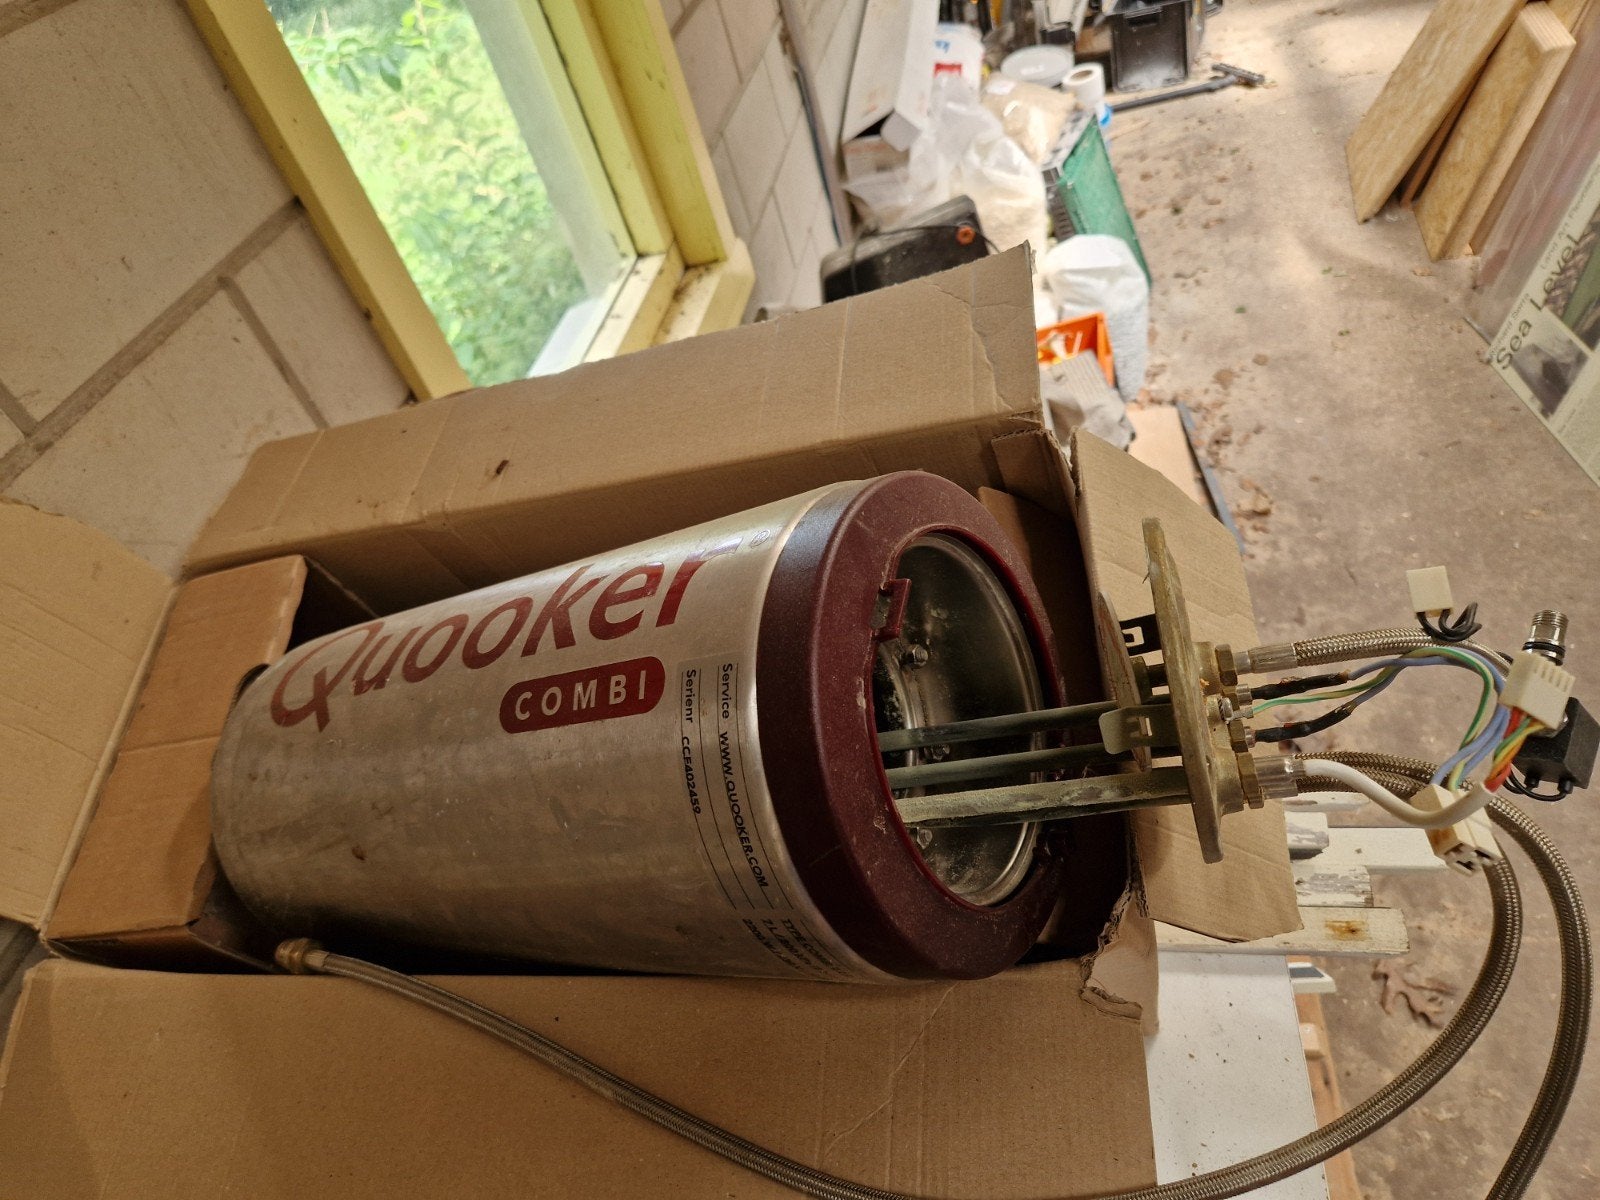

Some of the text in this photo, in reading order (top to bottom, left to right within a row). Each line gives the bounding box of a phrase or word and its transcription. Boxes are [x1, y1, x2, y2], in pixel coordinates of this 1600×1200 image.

[1497, 234, 1579, 370] Sea Level
[270, 537, 743, 732] Quooker
[515, 671, 646, 721] COMBI
[685, 669, 697, 723] Serienr
[719, 663, 769, 888] Service WWW.QUOOKER.COM
